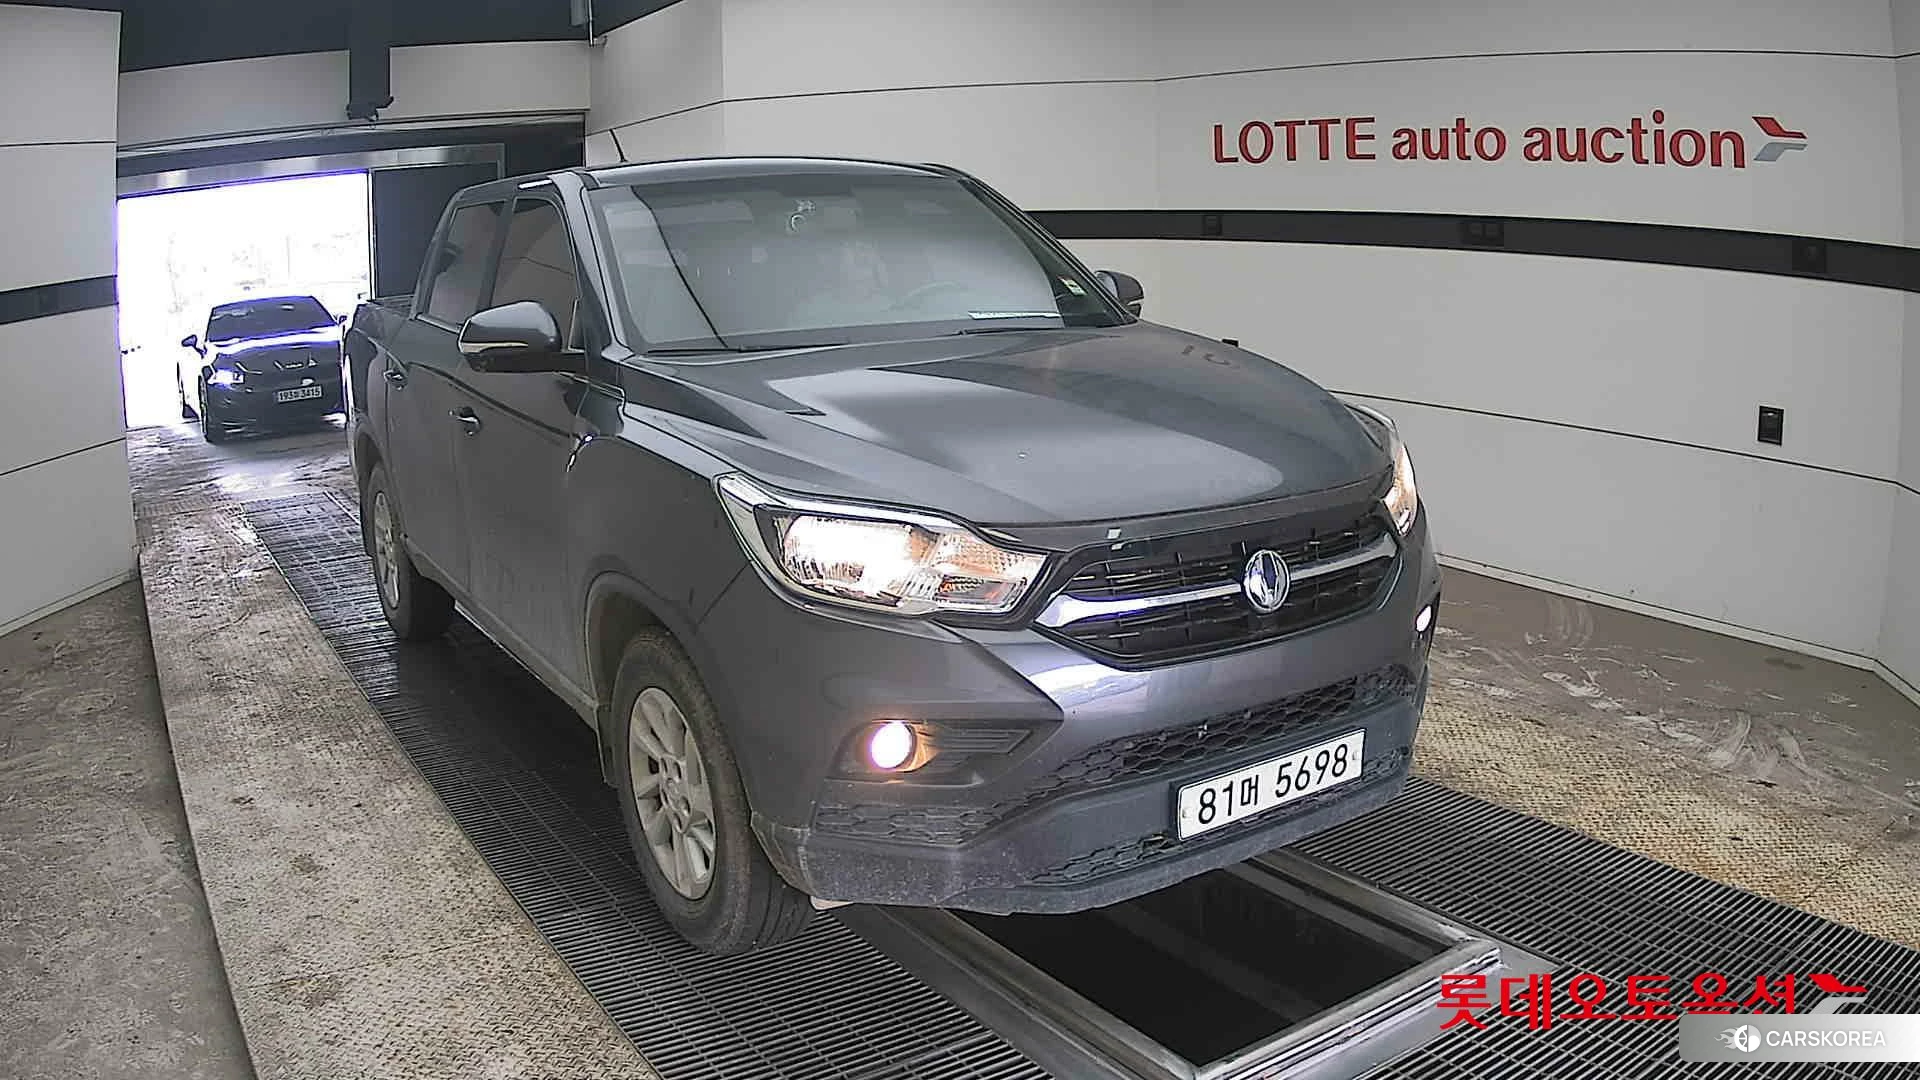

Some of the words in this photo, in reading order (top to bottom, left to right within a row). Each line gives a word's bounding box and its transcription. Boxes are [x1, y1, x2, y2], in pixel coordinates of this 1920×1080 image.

[1213, 116, 1377, 164] LOTTE
[1391, 117, 1507, 162] auto
[1522, 109, 1746, 169] auction
[1198, 774, 1260, 824] 81머
[1275, 743, 1348, 798] 5698
